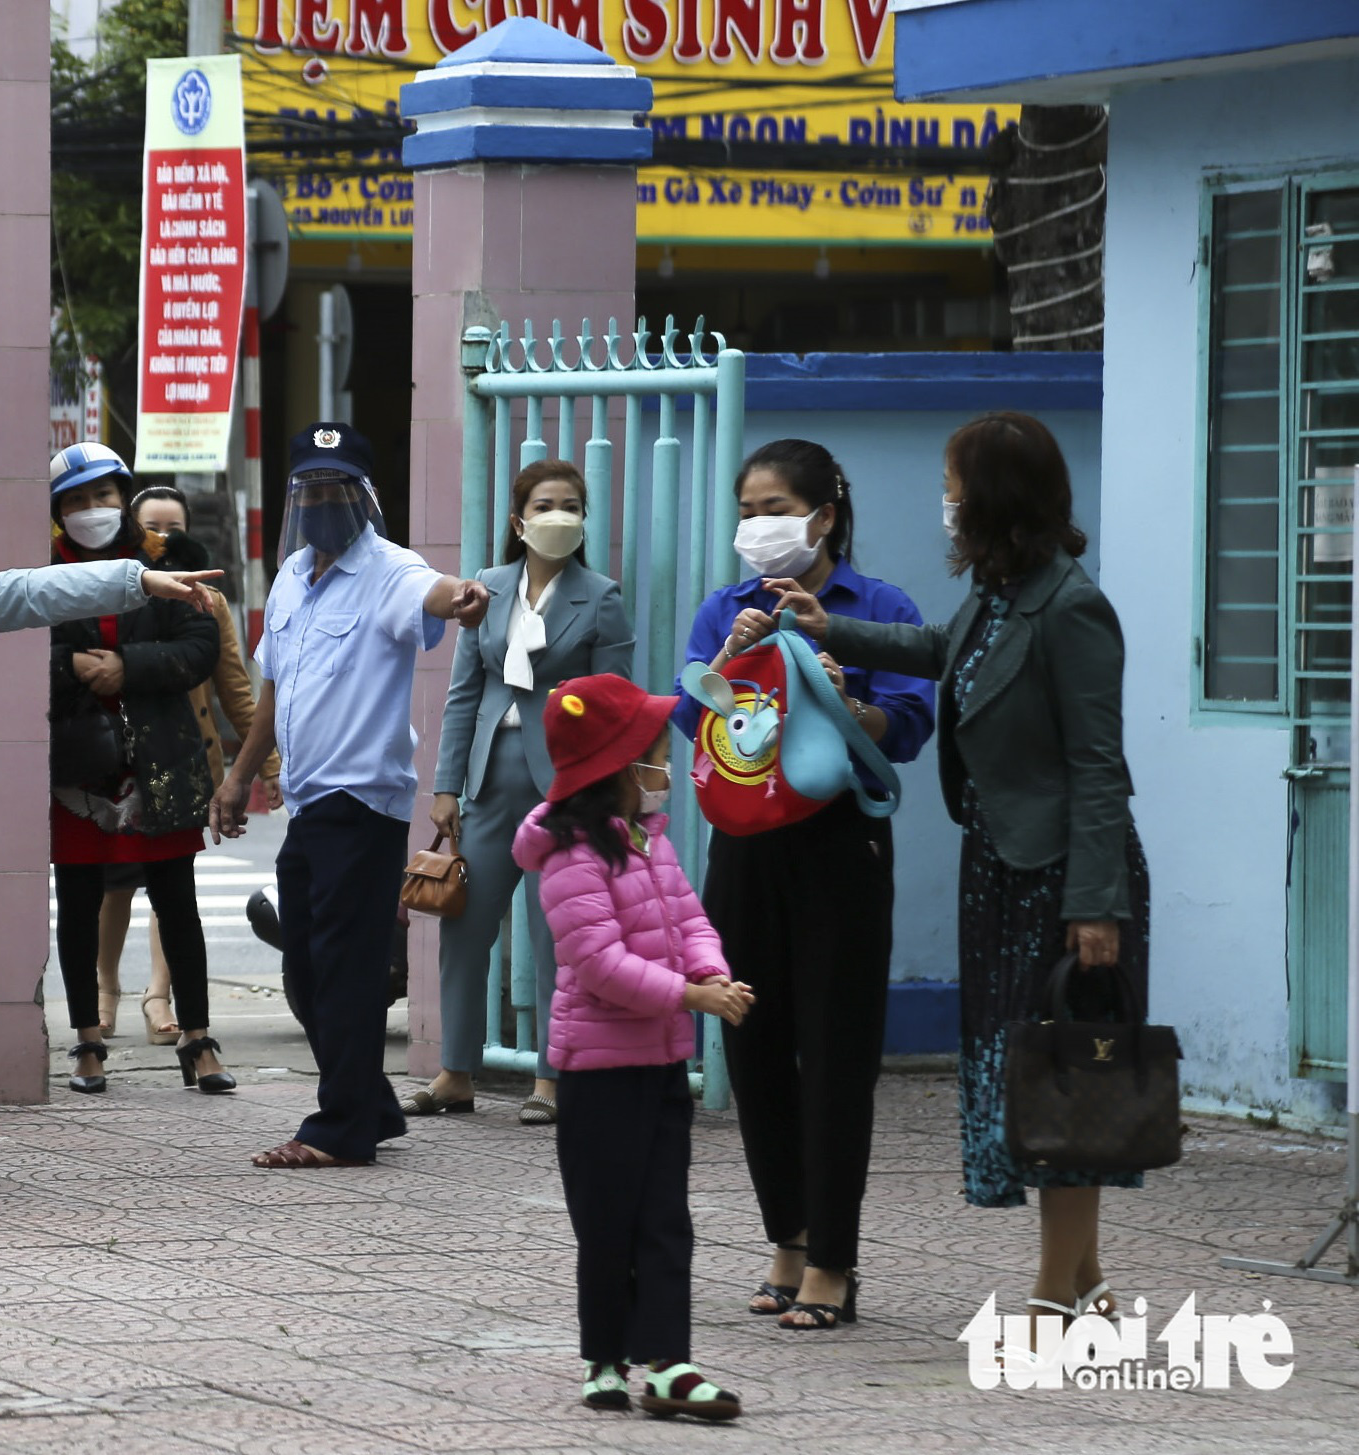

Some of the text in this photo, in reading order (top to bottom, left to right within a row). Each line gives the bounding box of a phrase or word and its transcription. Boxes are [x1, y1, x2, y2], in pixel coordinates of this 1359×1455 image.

[623, 0, 828, 66] SINH
[953, 107, 1018, 148] DÂ
[750, 178, 815, 211] Phay
[840, 176, 901, 208] Cơm
